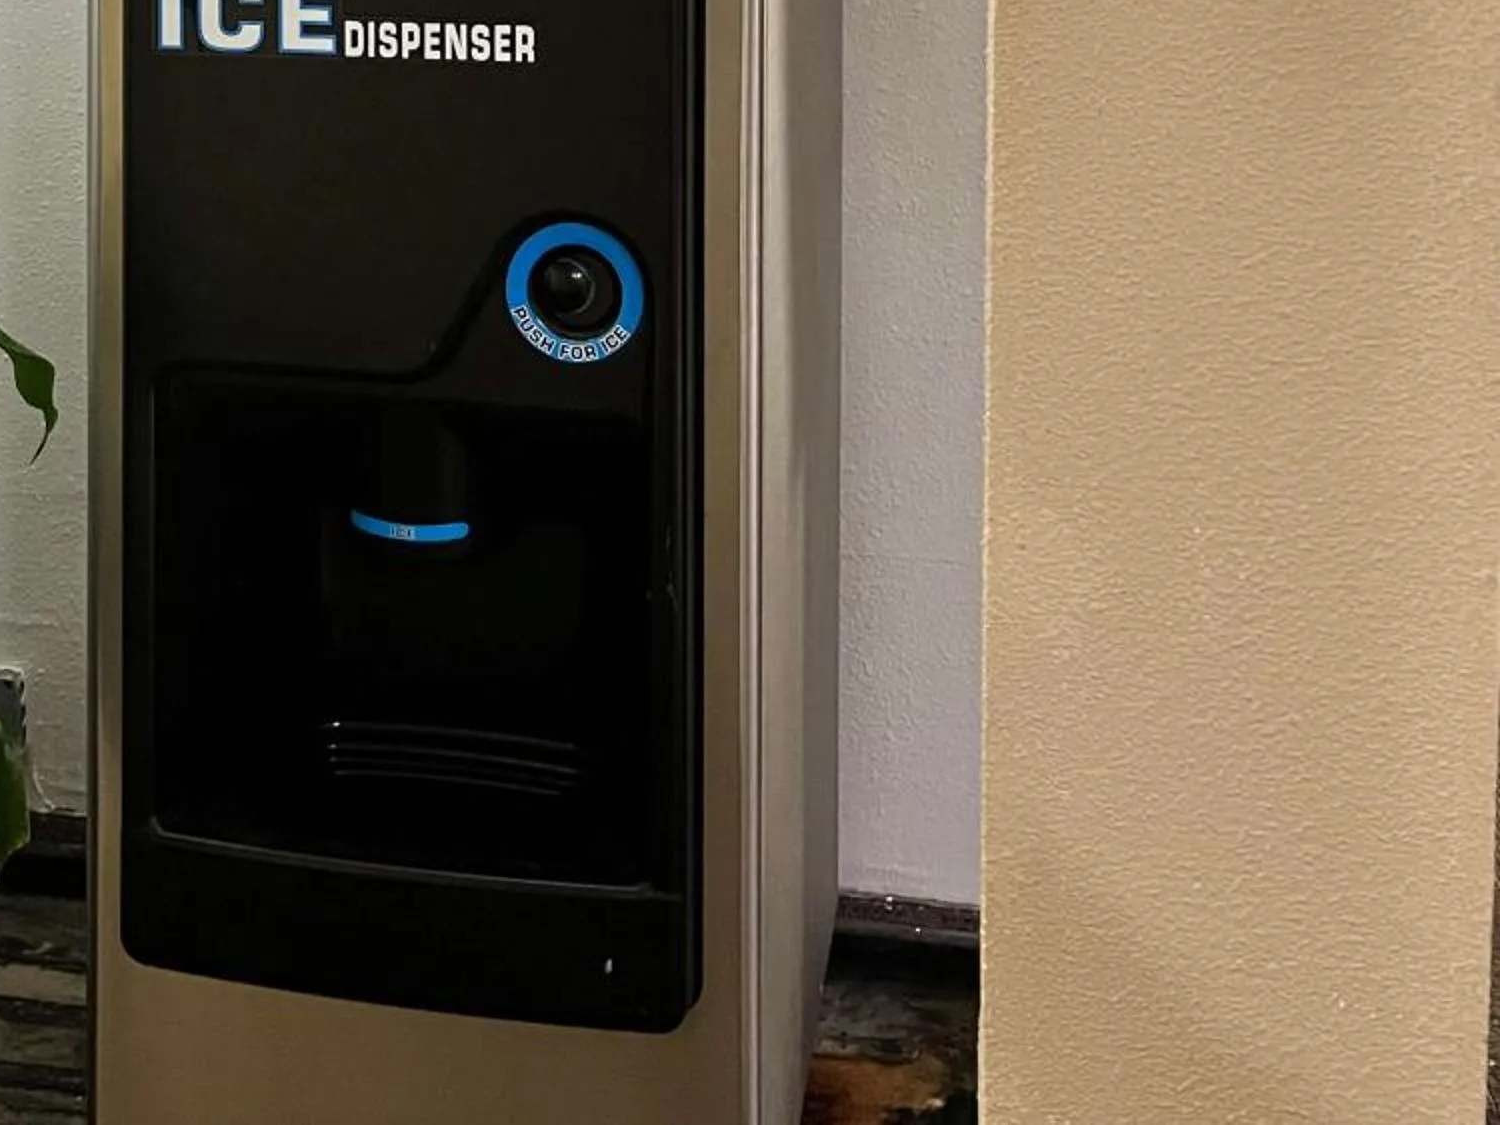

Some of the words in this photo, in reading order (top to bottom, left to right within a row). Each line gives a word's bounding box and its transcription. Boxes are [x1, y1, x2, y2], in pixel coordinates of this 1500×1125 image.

[344, 20, 536, 63] DISPENSER
[512, 307, 556, 354] PUSH
[559, 343, 598, 361] FOR
[601, 326, 629, 353] ICE
